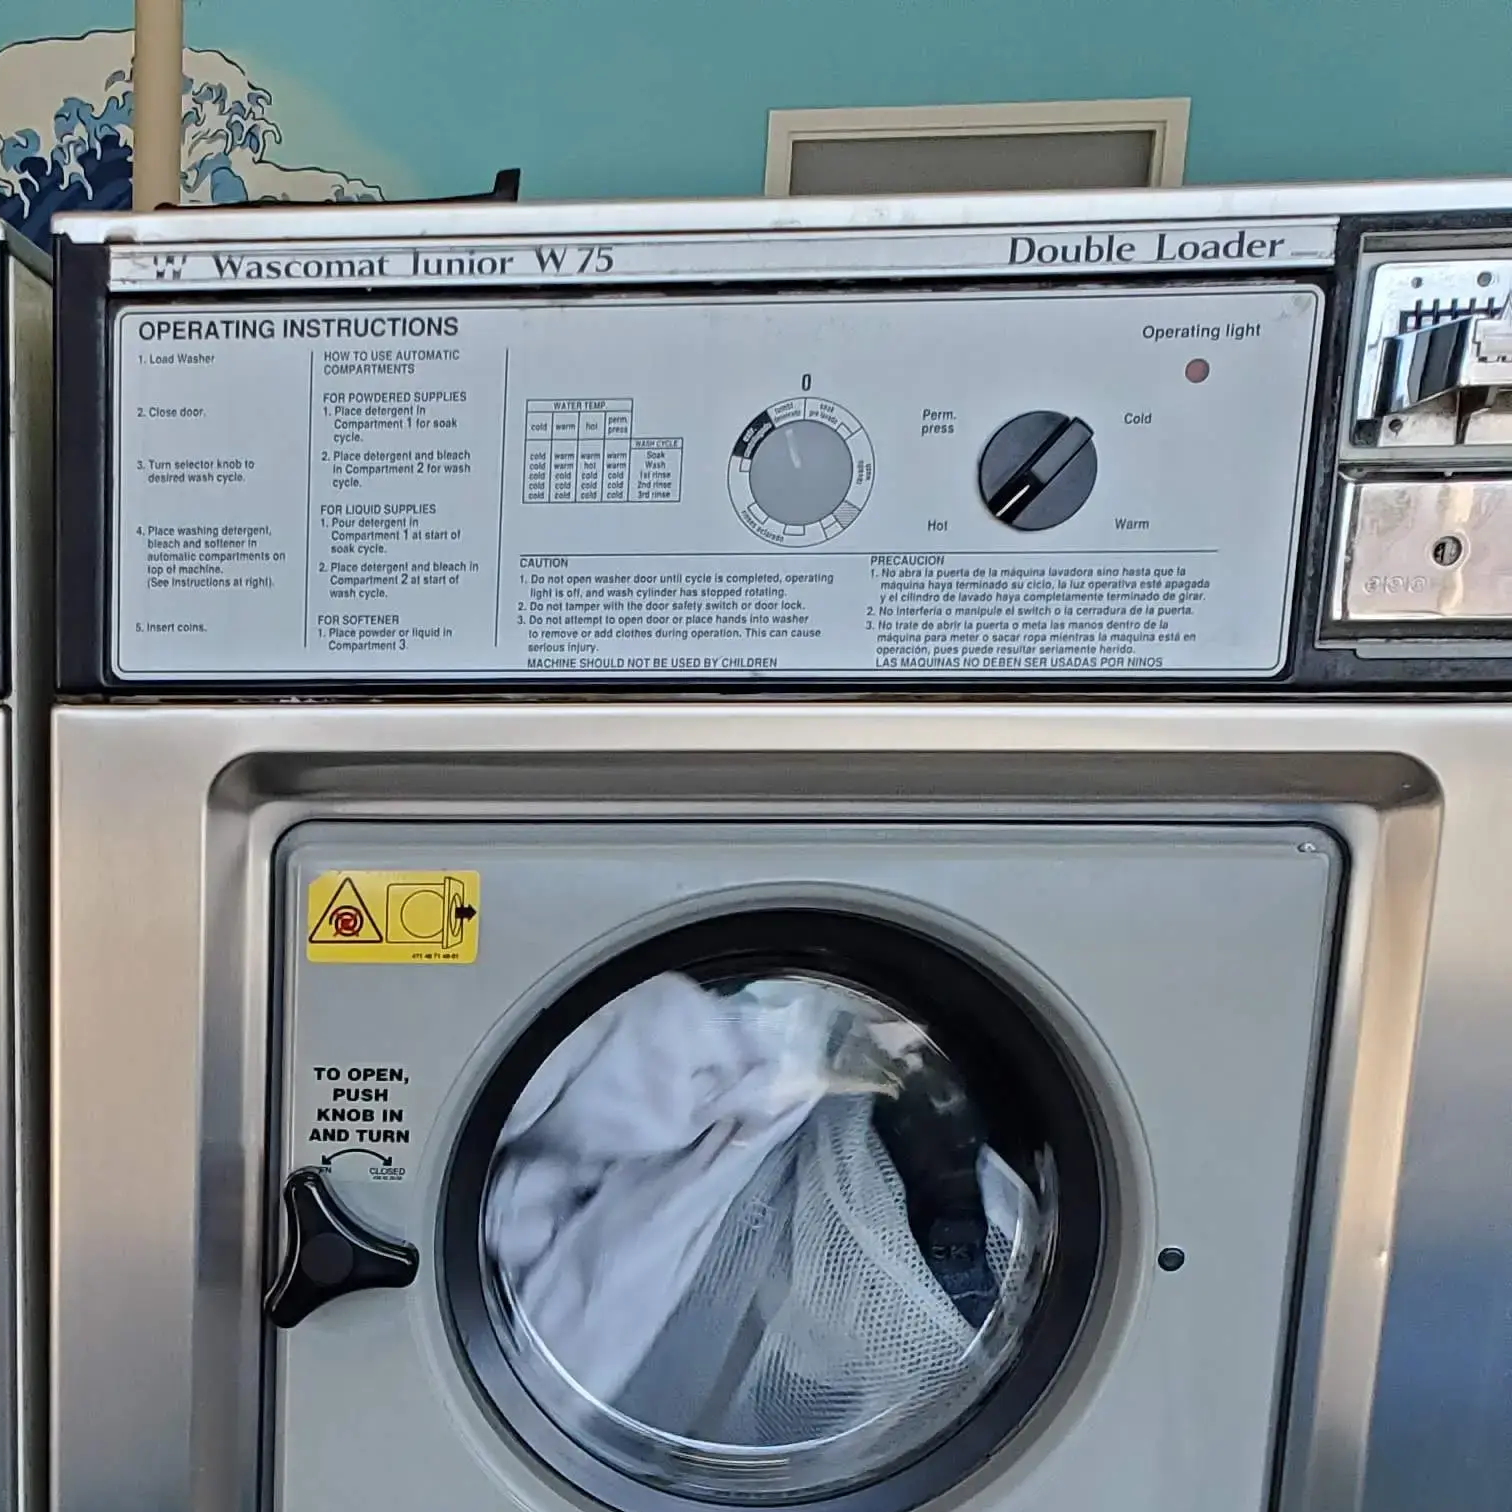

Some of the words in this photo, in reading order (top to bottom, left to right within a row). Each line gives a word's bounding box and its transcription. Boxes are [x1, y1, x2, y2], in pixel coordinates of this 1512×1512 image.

[1008, 234, 1135, 265] Double
[1156, 231, 1285, 261] Loader
[212, 252, 390, 279] Wascomat
[138, 320, 275, 341] OPERATING
[283, 316, 460, 339] INSTRUCTIONS
[1142, 323, 1220, 342] Operating
[1225, 323, 1261, 341] light
[149, 354, 174, 364] Load
[177, 354, 215, 364] Washer
[324, 350, 351, 361] HOW
[353, 350, 368, 361] TO
[371, 350, 393, 361] USE
[396, 350, 460, 361] AUTOMATIC
[324, 364, 415, 375] COMPARTMENTS
[323, 392, 346, 403] FOR
[348, 391, 411, 402] POWDERED
[413, 391, 467, 402] SUPPLIES
[149, 407, 177, 417] Close
[334, 406, 363, 416] Place
[365, 405, 414, 418] detergent
[416, 405, 426, 415] in
[922, 408, 957, 421] Perm.
[334, 418, 403, 431] Compartment
[407, 417, 412, 428] 1
[416, 418, 431, 428] for
[433, 418, 457, 428] soak
[1124, 412, 1152, 425] Cold
[921, 424, 955, 437] press
[333, 451, 361, 461] Place
[364, 450, 412, 463] detergent
[415, 450, 434, 460] and
[437, 450, 471, 460] bleach
[148, 460, 172, 469] Turn
[174, 459, 214, 469] selector
[217, 459, 242, 469] knob
[244, 459, 255, 469] to
[333, 463, 342, 474] in
[345, 463, 414, 476] Compartment
[417, 463, 424, 473] 2
[427, 463, 441, 473] for
[444, 462, 471, 473] wash
[148, 473, 185, 482] desired
[187, 472, 214, 482] wash
[320, 504, 343, 515] FOR
[345, 504, 382, 515] LIQUID
[384, 504, 436, 514] SUPPLIES
[927, 520, 948, 532] Hot
[1114, 518, 1150, 530] Warm
[148, 525, 175, 535] Place
[177, 525, 219, 538] washing
[147, 538, 181, 548] bleach
[183, 538, 202, 548] and
[204, 538, 246, 548] softener
[248, 538, 257, 548] in
[147, 551, 197, 561] automatic
[199, 551, 270, 563] compartments
[273, 553, 286, 561] on
[520, 558, 569, 568] CAUTION
[147, 564, 164, 576] top
[166, 564, 176, 574] of
[531, 573, 545, 584] Do
[547, 573, 564, 584] not
[567, 576, 592, 586] open
[595, 573, 631, 584] washer
[633, 573, 658, 583] door
[660, 573, 682, 583] until
[685, 573, 712, 586] cycle
[714, 573, 724, 583] is
[785, 572, 834, 585] operating
[530, 587, 552, 600] light
[555, 587, 564, 598] is
[585, 587, 605, 597] and
[607, 587, 634, 597] wash
[636, 587, 678, 600] cylinder
[679, 587, 698, 597] has
[701, 587, 743, 599] stopped
[318, 615, 340, 625] FOR
[342, 614, 399, 625] SOFTENER
[147, 622, 175, 632] Insert
[527, 658, 577, 668] MACHINE
[579, 658, 625, 668] SHOULD
[627, 658, 651, 668] NOT
[653, 658, 668, 668] BE
[671, 658, 701, 668] USED
[704, 657, 721, 668] BY
[720, 657, 777, 668] CHILDREN
[876, 657, 898, 668] LAS
[963, 657, 980, 667] NO
[983, 657, 1022, 667] DEBEN
[1024, 657, 1048, 667] SER
[1051, 657, 1097, 667] USADAS
[1100, 657, 1125, 667] POR
[313, 1067, 340, 1081] TO
[347, 1067, 409, 1085] OPEN,
[332, 1087, 389, 1102] PUSH
[316, 1108, 375, 1122] KNOB
[382, 1109, 404, 1122] IN
[308, 1128, 350, 1142] AND
[355, 1129, 410, 1143] TURN
[369, 1167, 406, 1175] CLOSED
